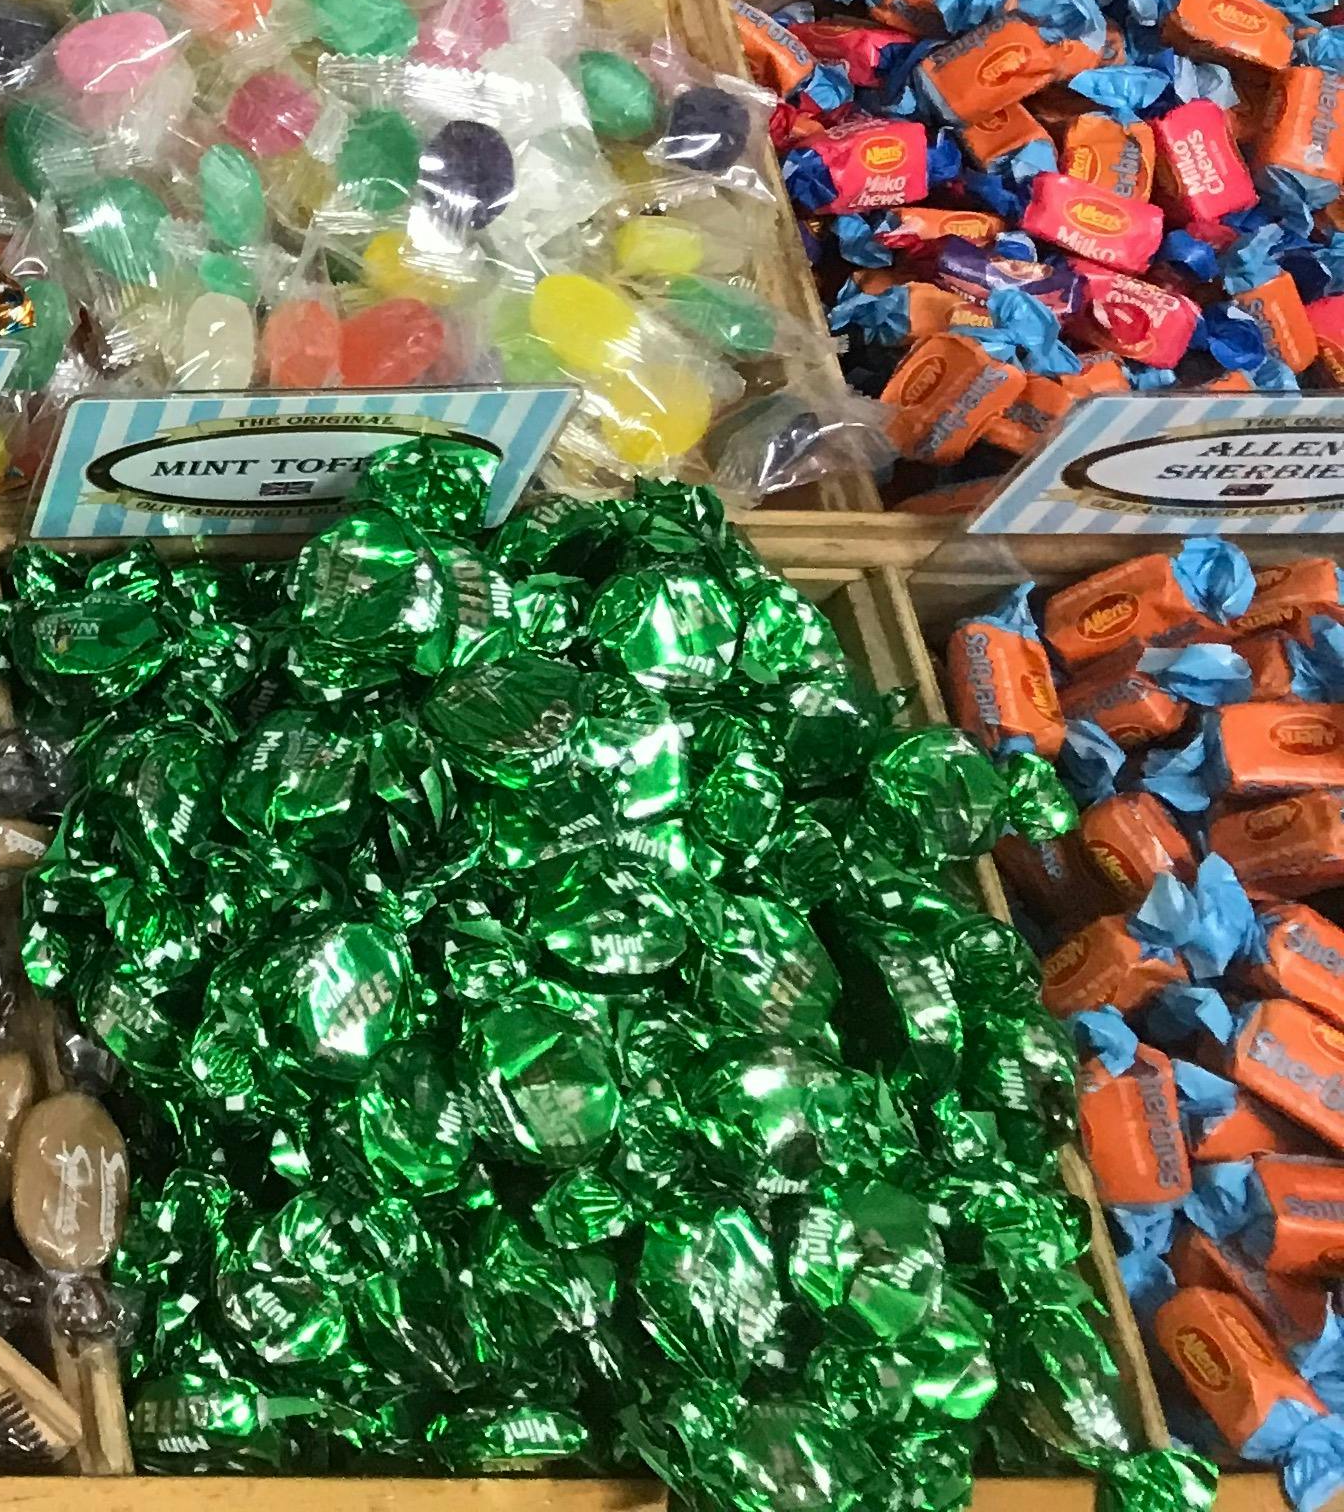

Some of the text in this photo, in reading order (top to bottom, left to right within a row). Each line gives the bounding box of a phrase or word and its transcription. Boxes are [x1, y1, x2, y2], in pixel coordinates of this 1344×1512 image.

[1212, 4, 1271, 32] Allen's
[861, 139, 907, 168] Allen's
[1173, 138, 1200, 198] Milko
[1192, 128, 1226, 197] Chews
[863, 174, 907, 193] Milko
[1069, 202, 1128, 233] Allen's
[1056, 227, 1118, 261] Milko
[236, 415, 395, 428] THE ORIGINAL
[151, 454, 374, 478] MINT TOFF
[135, 500, 175, 513] OLD
[176, 503, 290, 518] FASHIONED
[1082, 598, 1135, 633] Allen's
[1001, 1058, 1028, 1111] Mint
